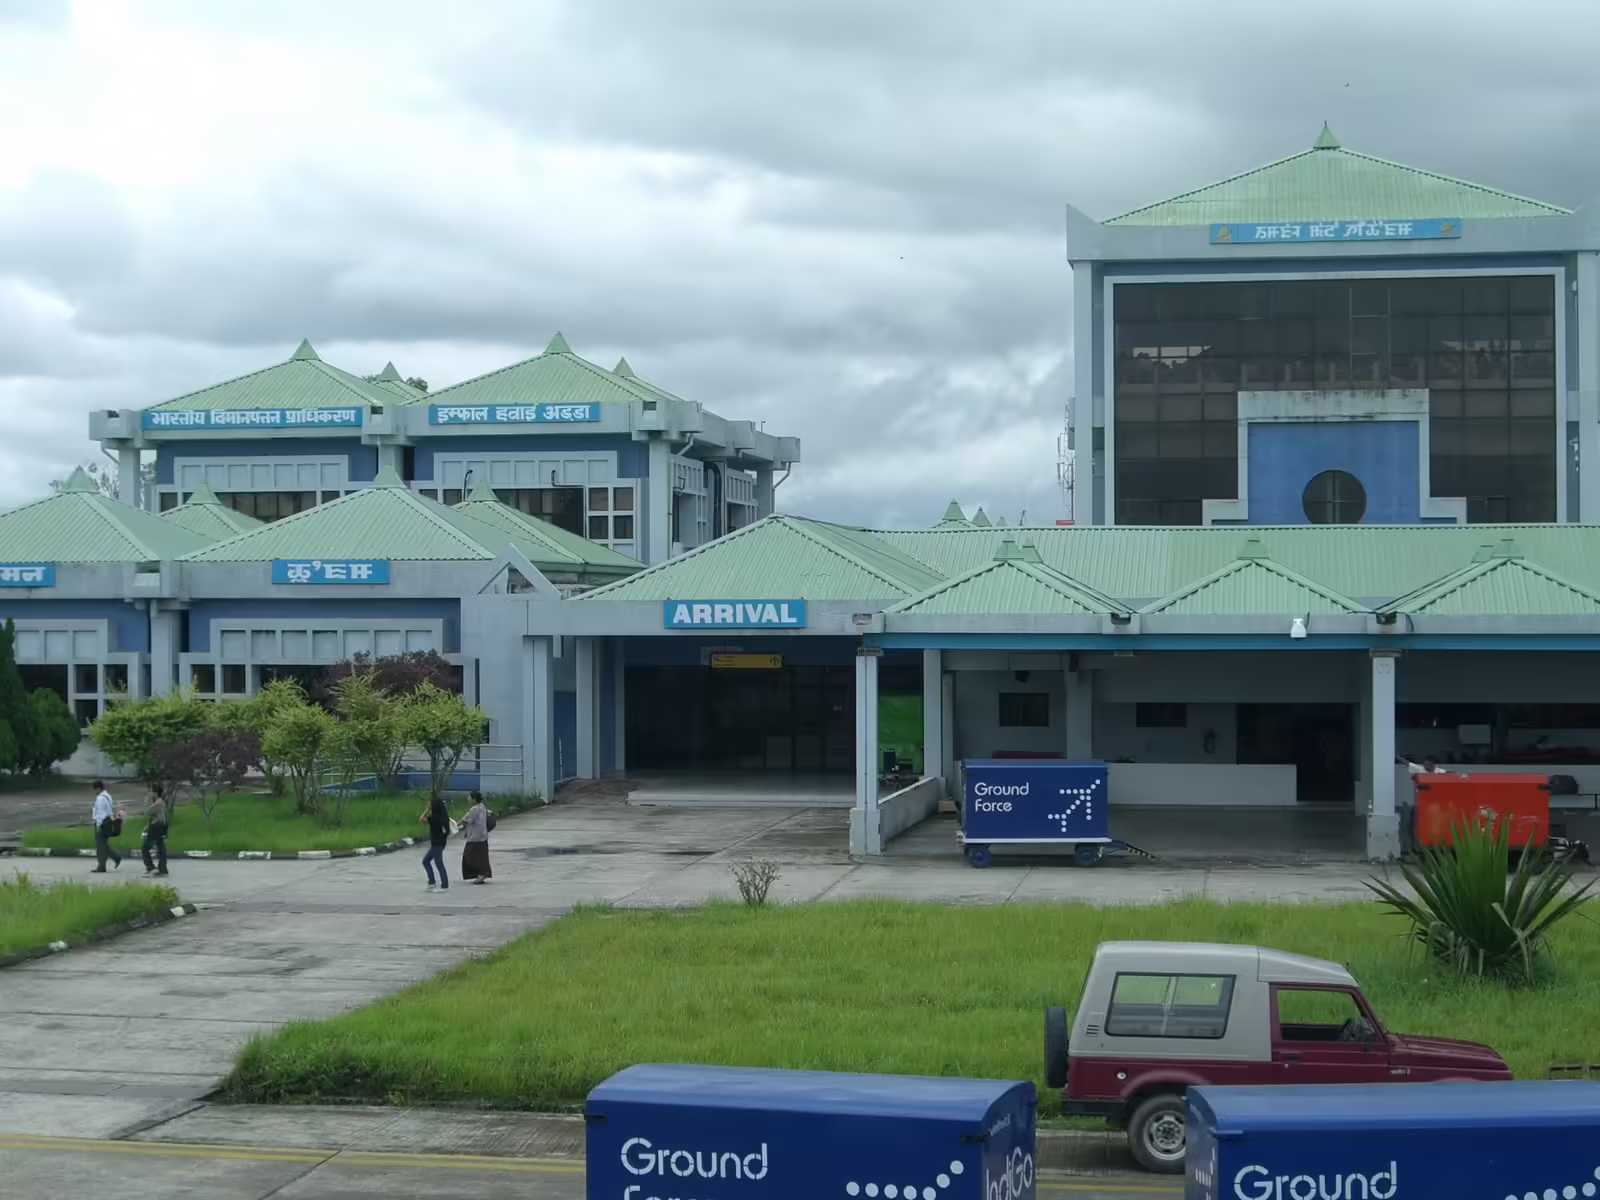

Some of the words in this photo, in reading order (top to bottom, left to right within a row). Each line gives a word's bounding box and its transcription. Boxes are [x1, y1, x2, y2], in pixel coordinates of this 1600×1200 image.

[151, 410, 206, 425] भारतीय
[210, 409, 281, 425] विमानपत्तन
[285, 408, 356, 424] प्राधिकरण
[437, 407, 489, 423] इम्फाल
[495, 403, 537, 422] हवाई
[673, 603, 797, 624] ARRIVAL
[974, 782, 1029, 796] Ground
[975, 798, 1013, 812] Force
[620, 1137, 768, 1180] Ground
[1234, 1160, 1397, 1200] Ground
